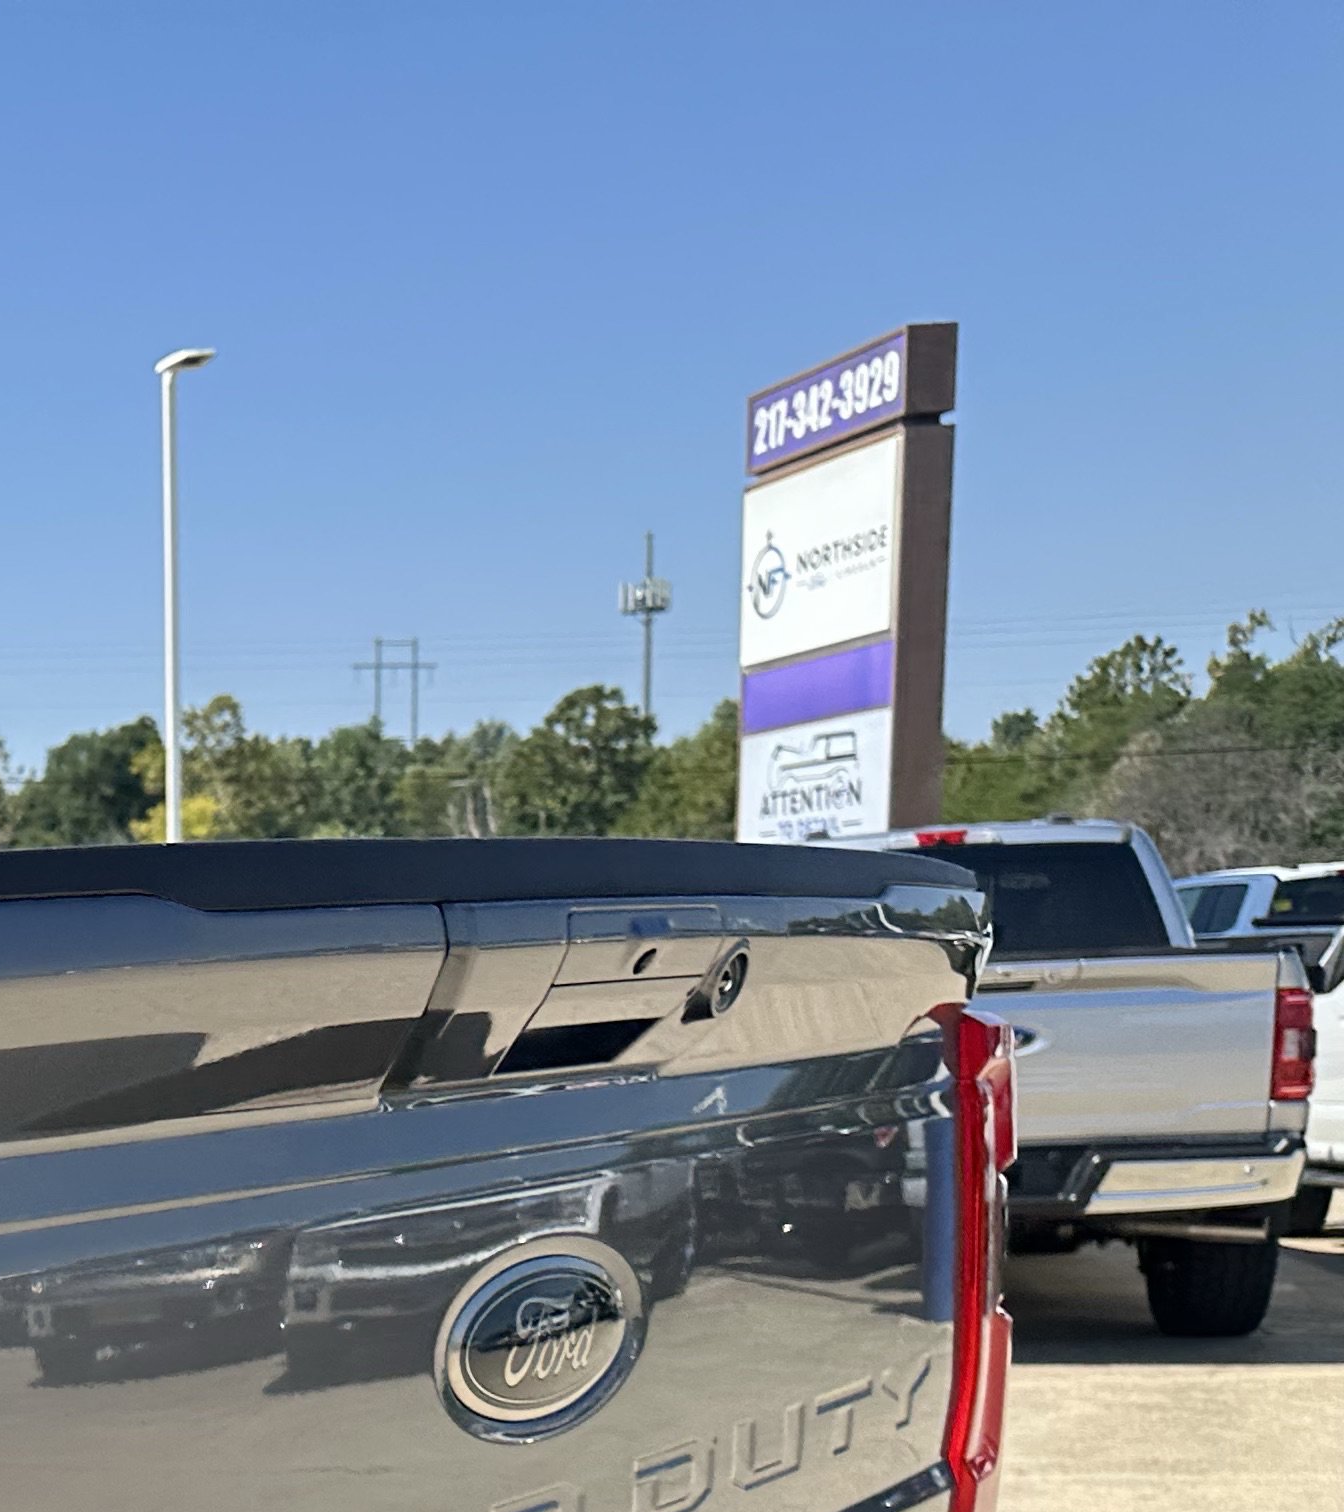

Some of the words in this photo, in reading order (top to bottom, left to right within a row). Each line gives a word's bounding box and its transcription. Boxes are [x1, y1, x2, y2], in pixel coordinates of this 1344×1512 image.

[753, 351, 900, 456] 217-342-3929
[796, 524, 889, 575] NORTHSIDE
[759, 777, 862, 820] ATTENTION
[503, 1297, 600, 1388] Ford
